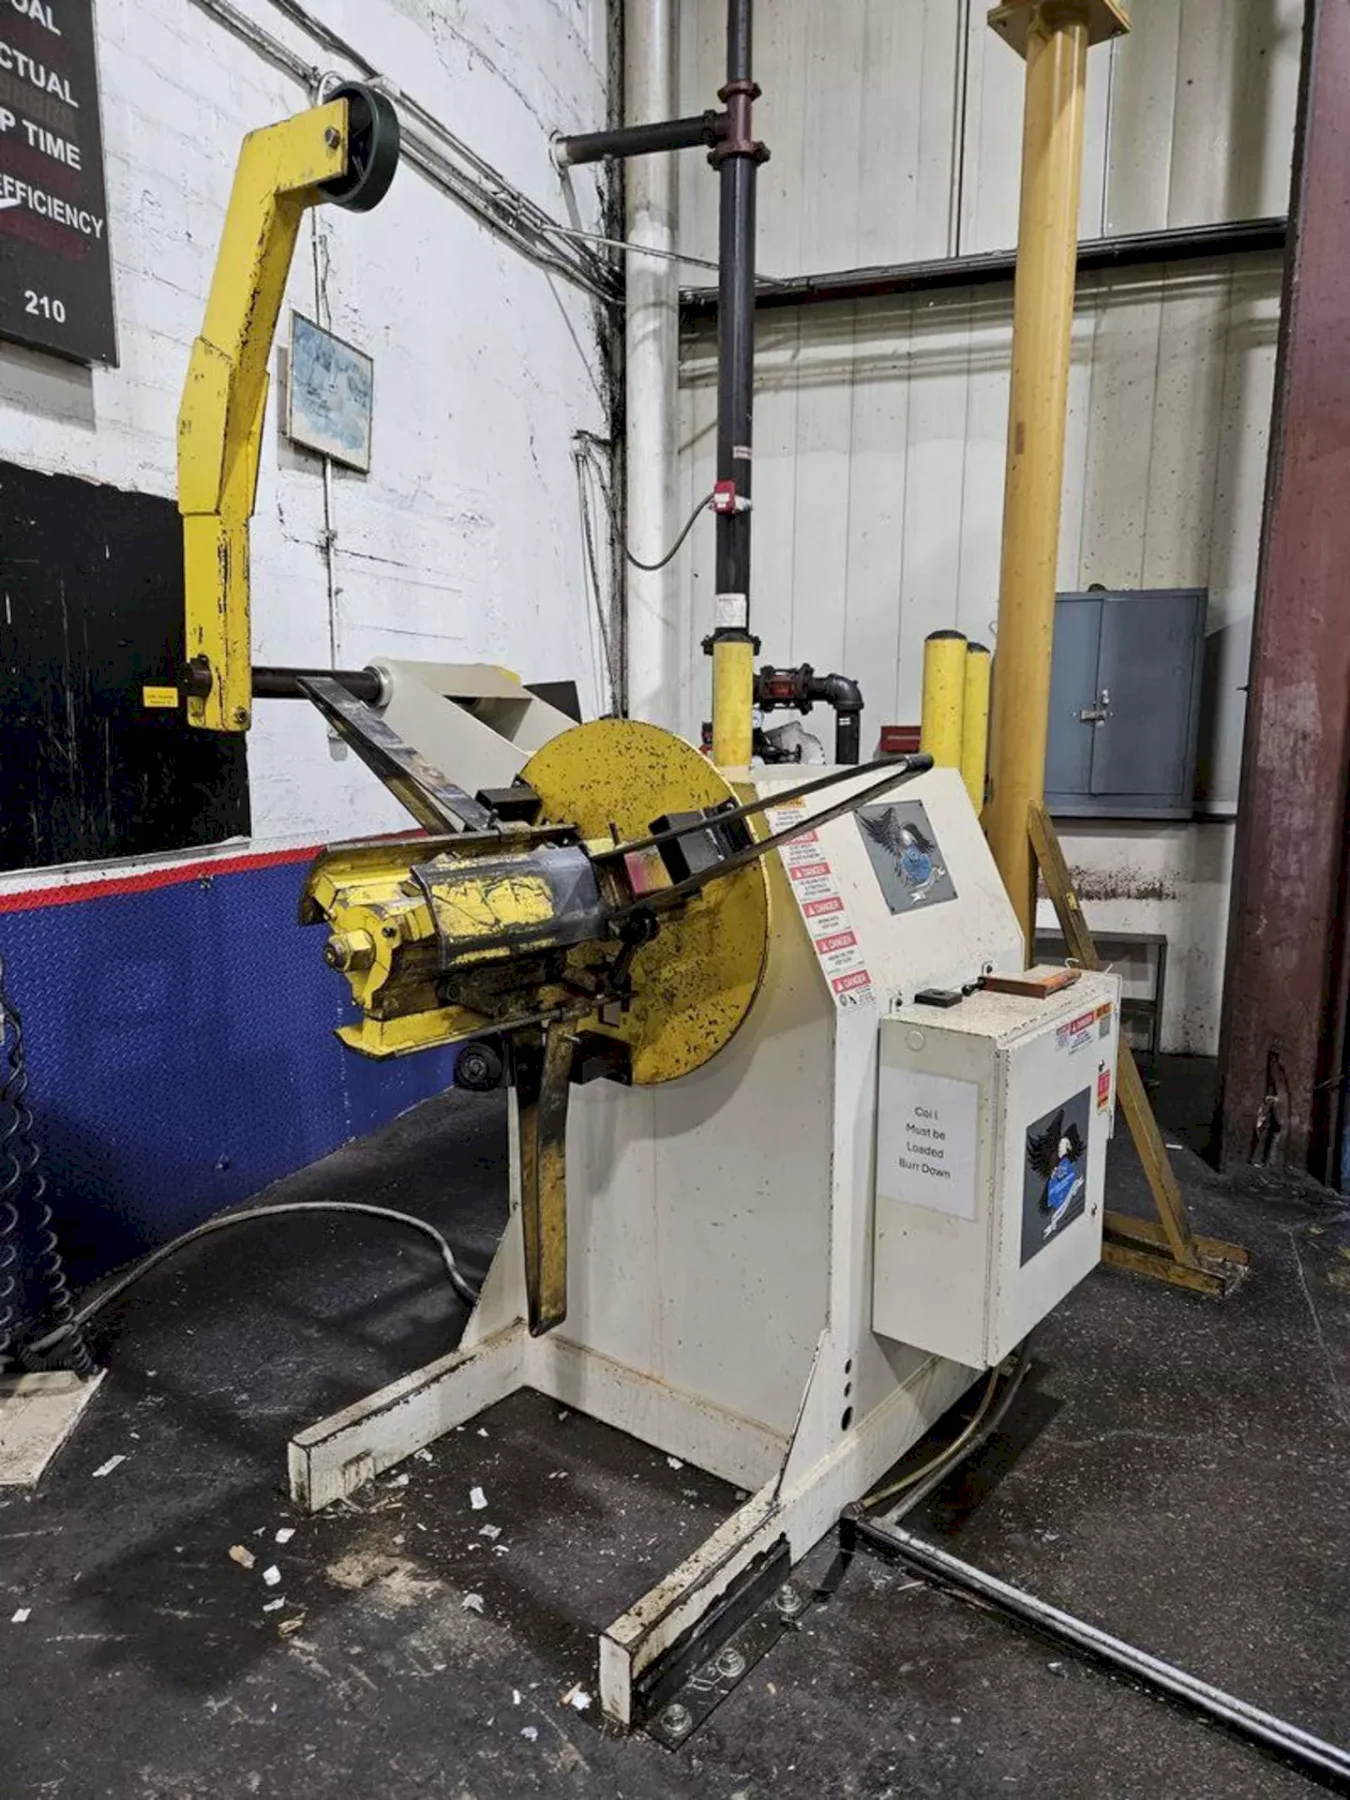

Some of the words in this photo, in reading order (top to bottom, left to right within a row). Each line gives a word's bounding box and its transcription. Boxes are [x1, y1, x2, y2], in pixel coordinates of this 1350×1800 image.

[21, 119, 82, 171] TIME
[0, 173, 103, 239] FFICIENCY
[24, 289, 66, 324] 210
[906, 1122, 931, 1138] Must
[932, 1129, 946, 1141] be
[906, 1141, 944, 1159] Loaded
[899, 1157, 920, 1171] Burr
[921, 1163, 951, 1179] Down
